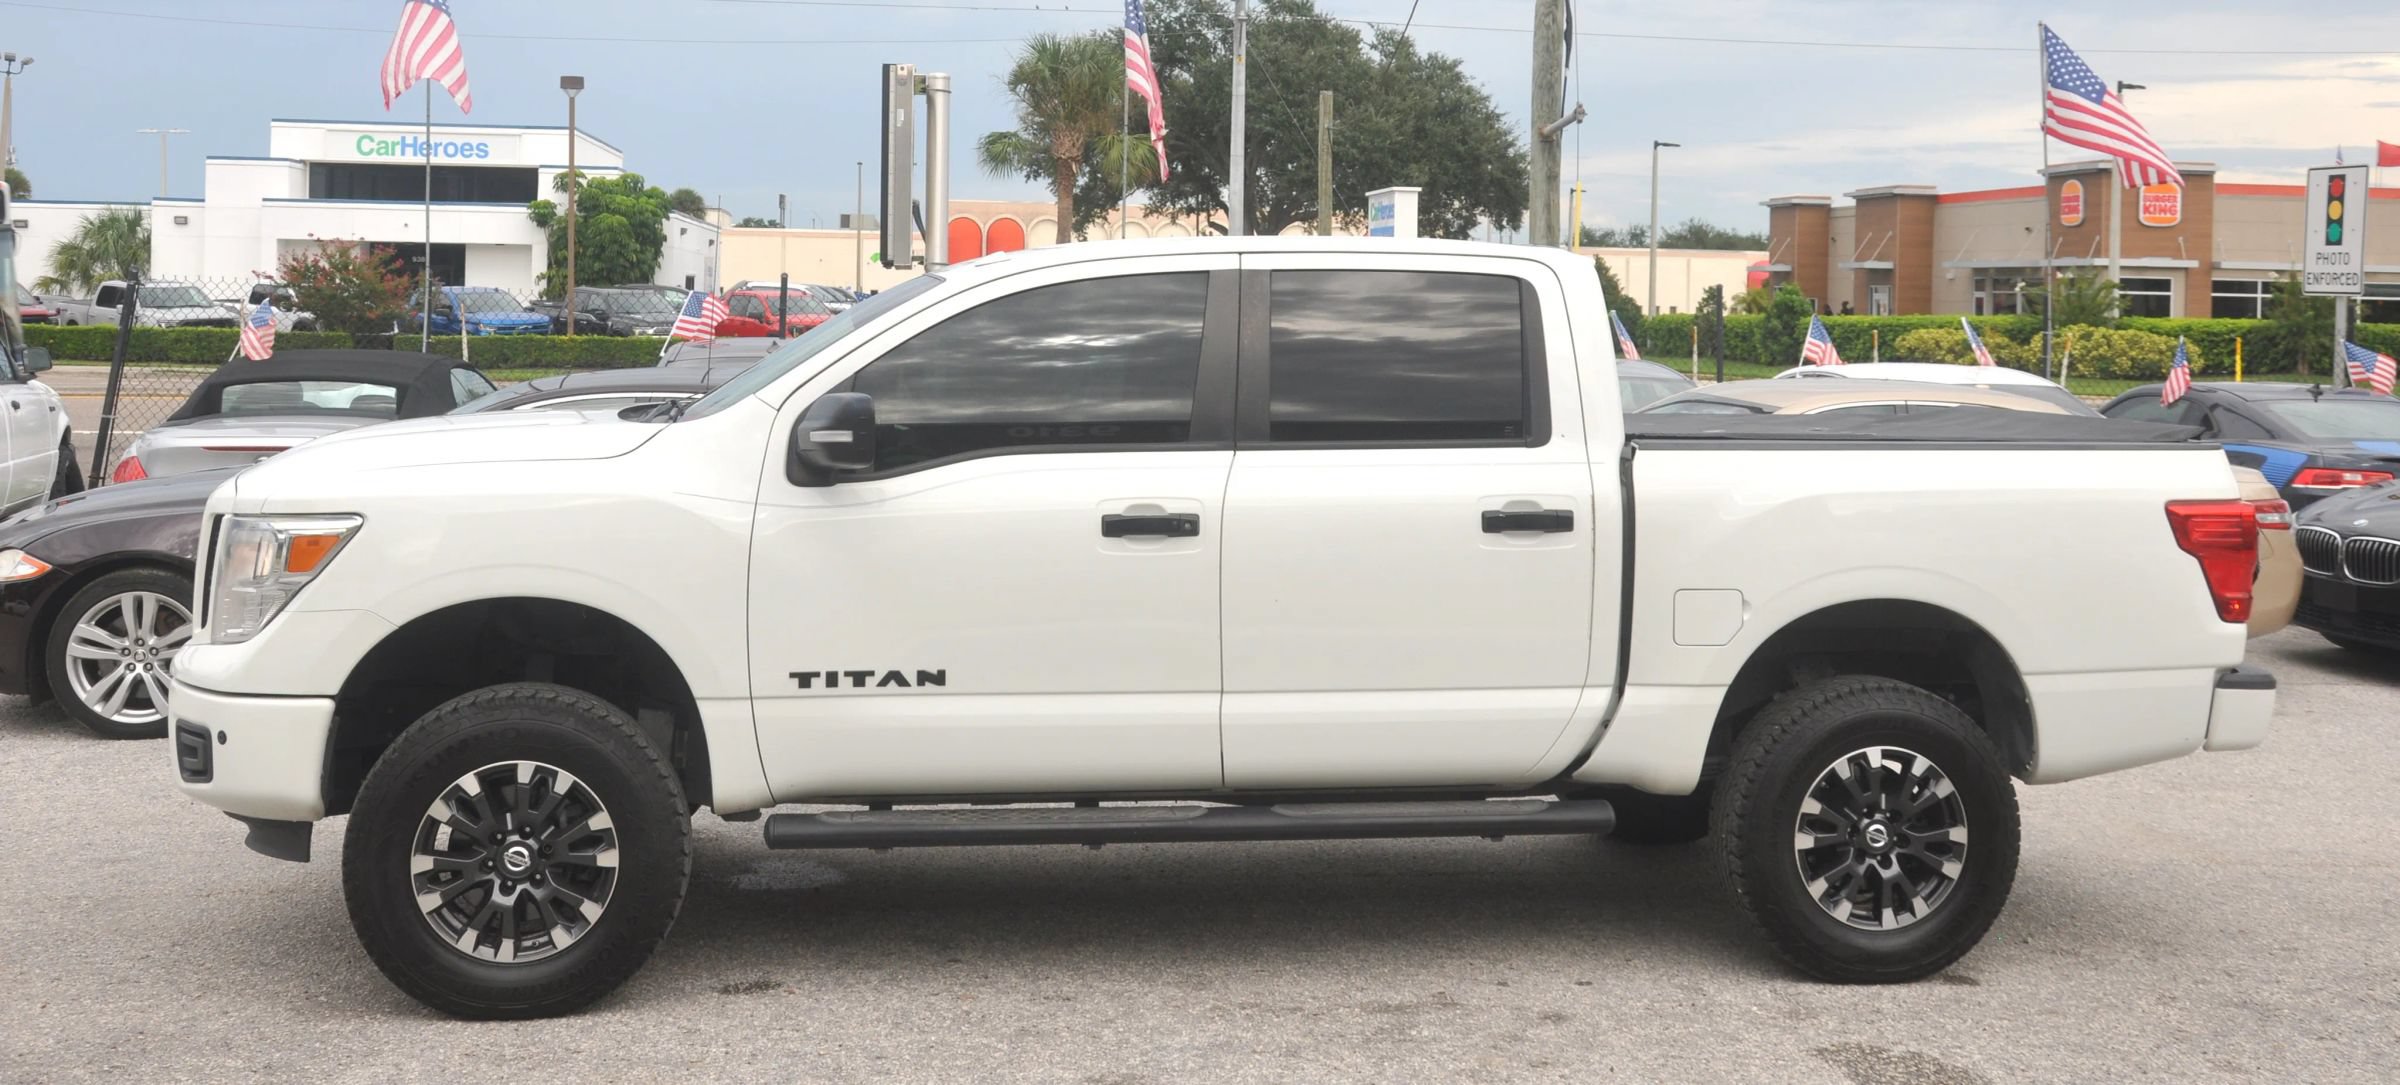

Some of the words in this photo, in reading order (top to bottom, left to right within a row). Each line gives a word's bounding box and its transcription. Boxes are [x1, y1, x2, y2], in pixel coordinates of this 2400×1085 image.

[356, 134, 489, 159] CarHeroes
[2143, 194, 2178, 203] BURGER
[2143, 203, 2178, 216] KING
[2315, 251, 2350, 265] PHOTO
[2306, 272, 2359, 286] ENFORCED
[789, 669, 946, 689] TITAN
